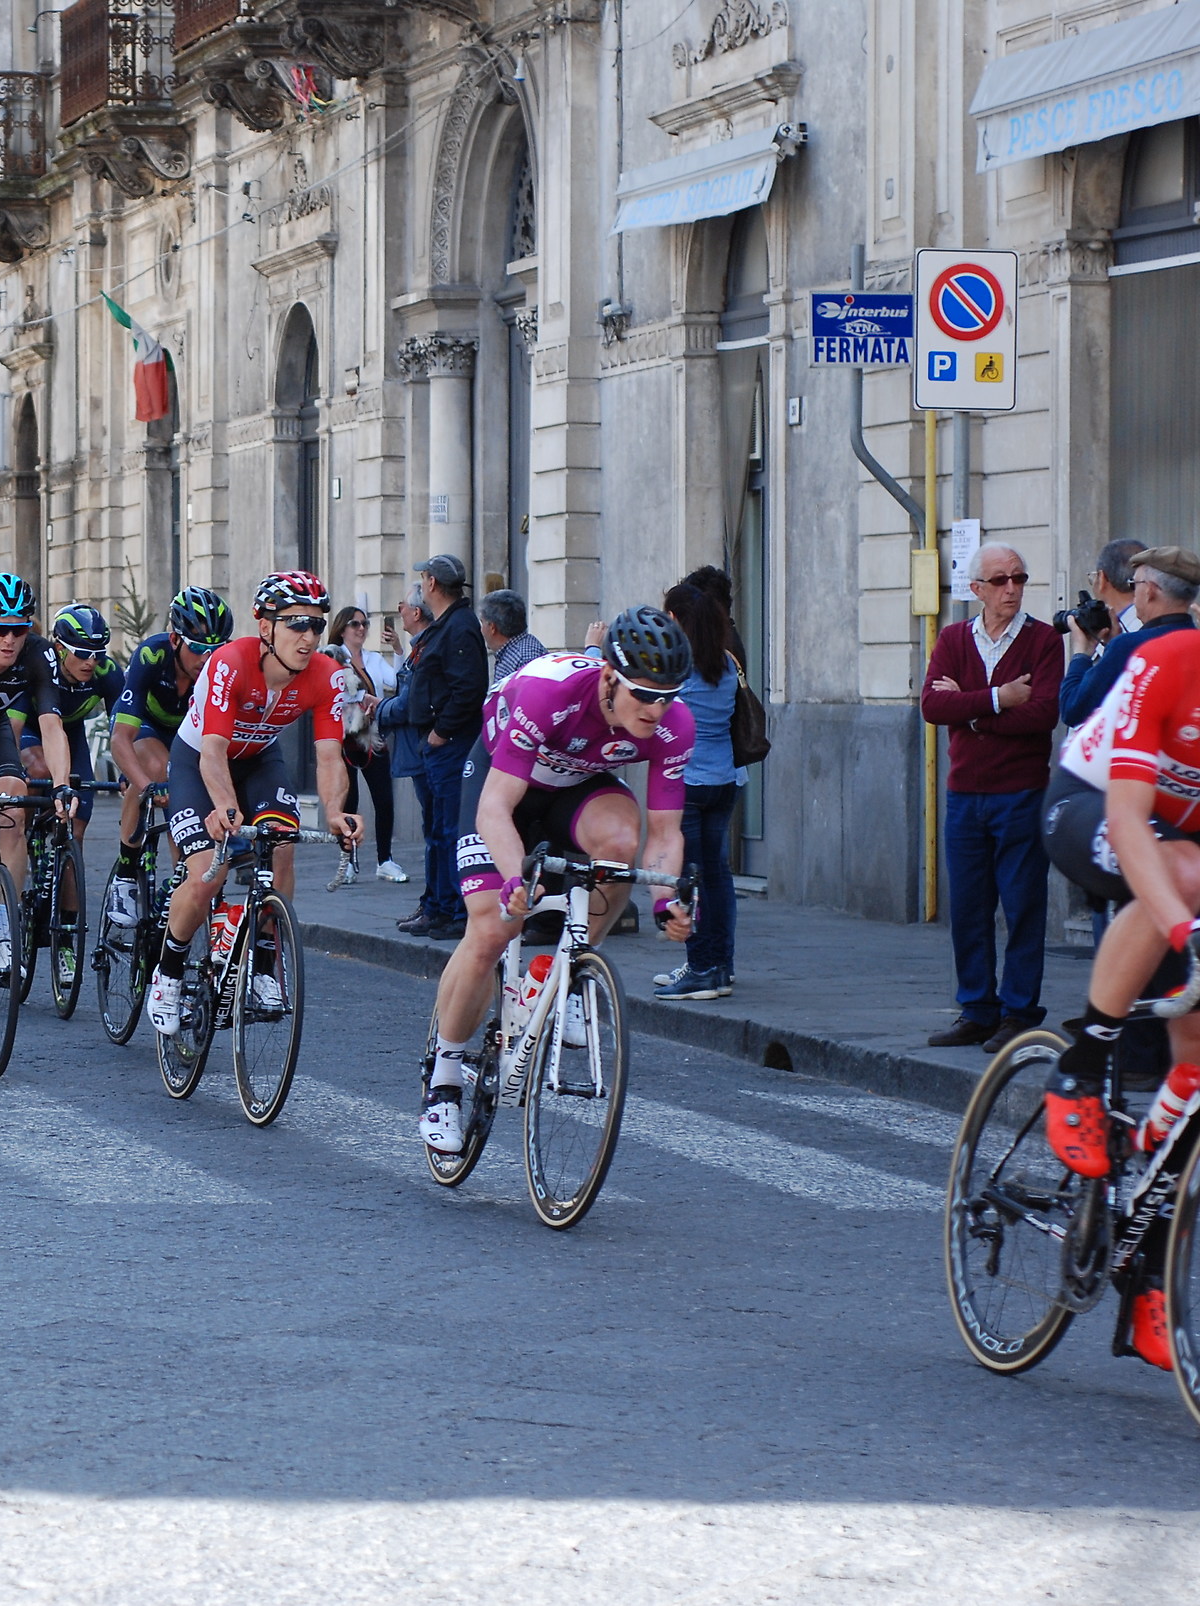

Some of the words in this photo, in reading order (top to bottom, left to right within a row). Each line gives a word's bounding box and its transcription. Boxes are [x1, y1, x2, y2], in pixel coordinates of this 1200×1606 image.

[1008, 98, 1076, 155] PESCE
[1085, 69, 1184, 134] FRESCO
[838, 299, 909, 319] interbus
[845, 321, 882, 334] ETNA
[814, 337, 909, 363] FERMATA
[934, 354, 952, 378] P
